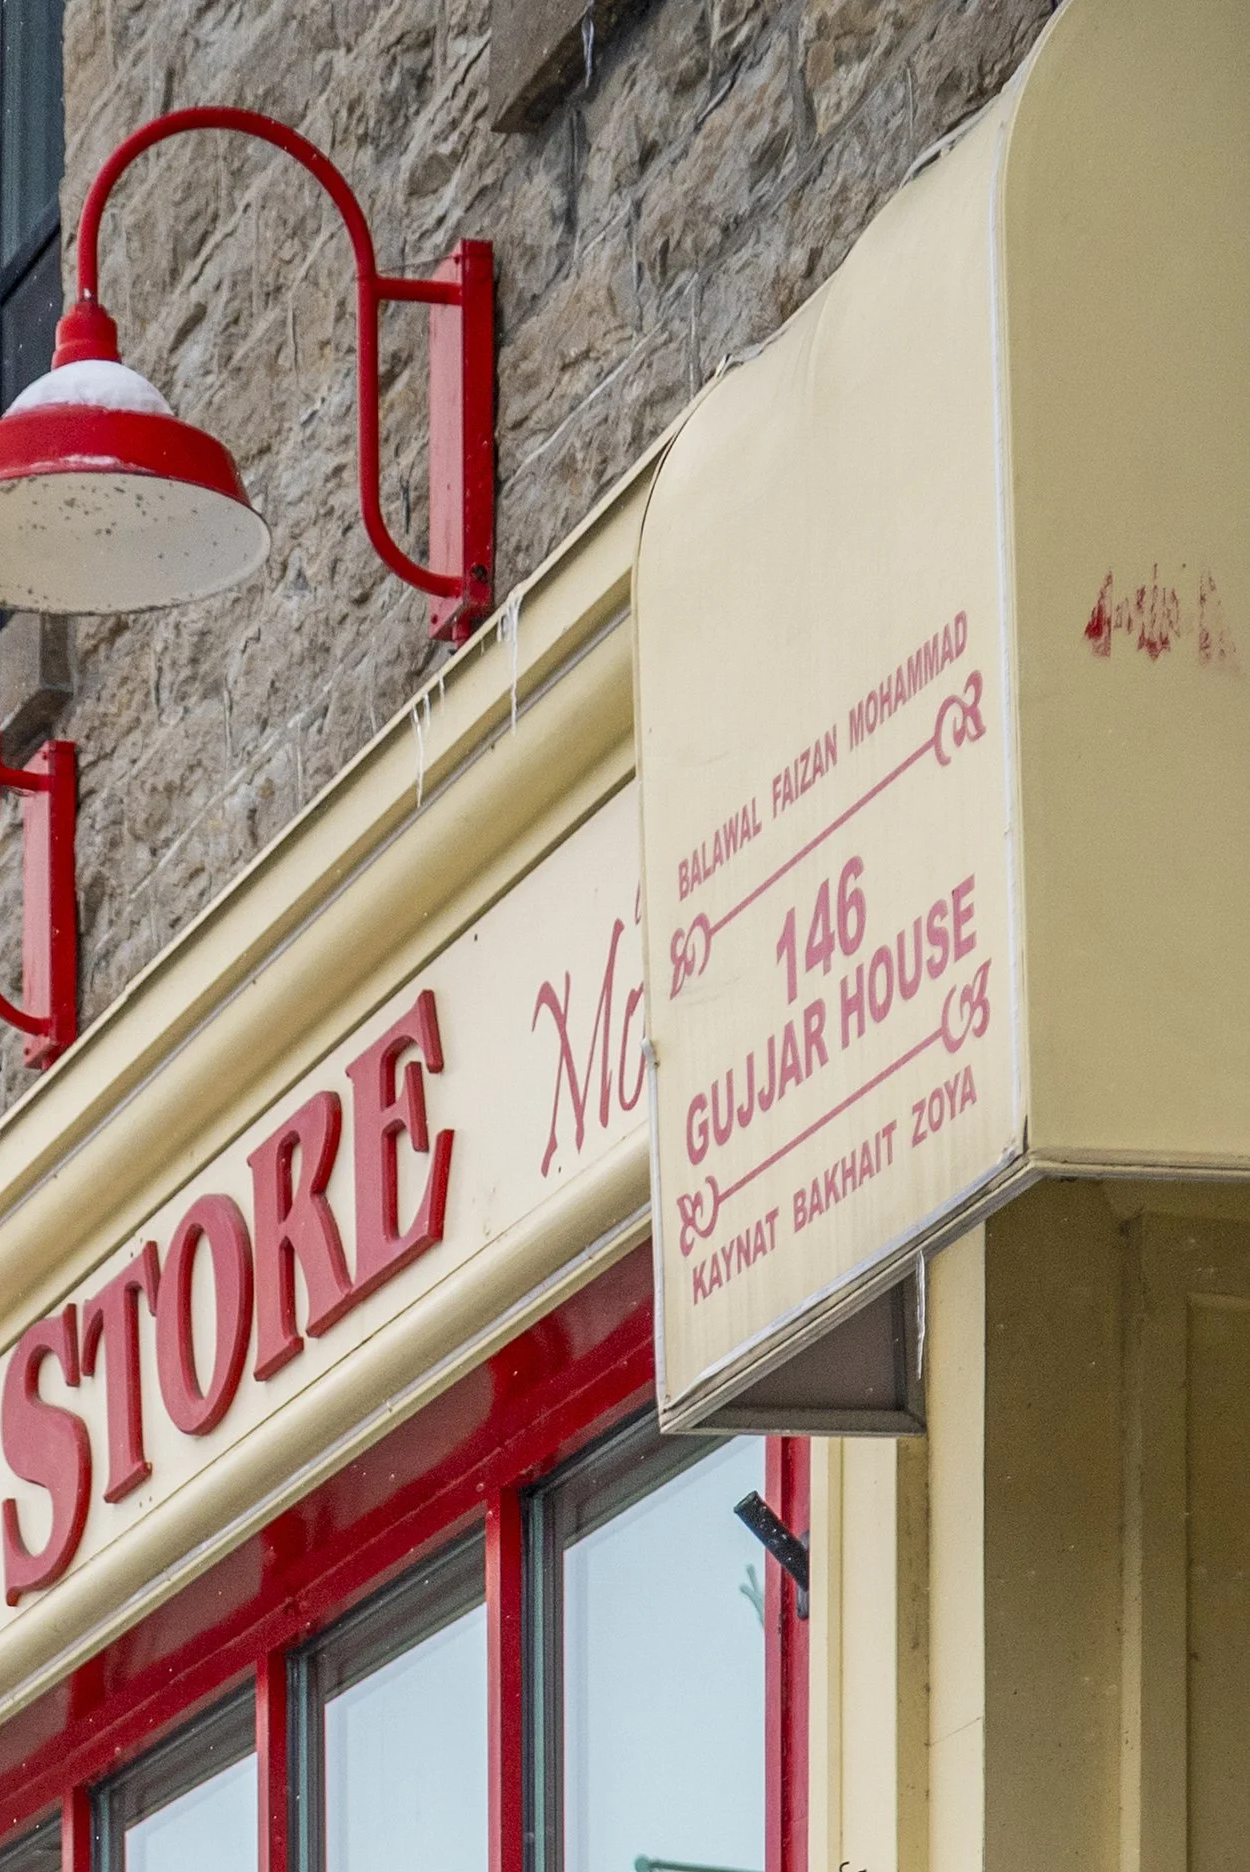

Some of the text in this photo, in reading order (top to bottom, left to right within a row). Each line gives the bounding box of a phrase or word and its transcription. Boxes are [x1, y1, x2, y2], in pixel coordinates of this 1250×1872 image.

[678, 797, 762, 902] BALAWAL
[771, 724, 839, 818] FAIZAN
[849, 610, 969, 751] MOHAMMAD
[686, 875, 978, 1166] GUJJAR HOUSE
[776, 855, 867, 1003] 146
[1, 989, 455, 1607] STORE
[693, 1065, 978, 1305] KAYNAT BAKHAIT ZOYA
